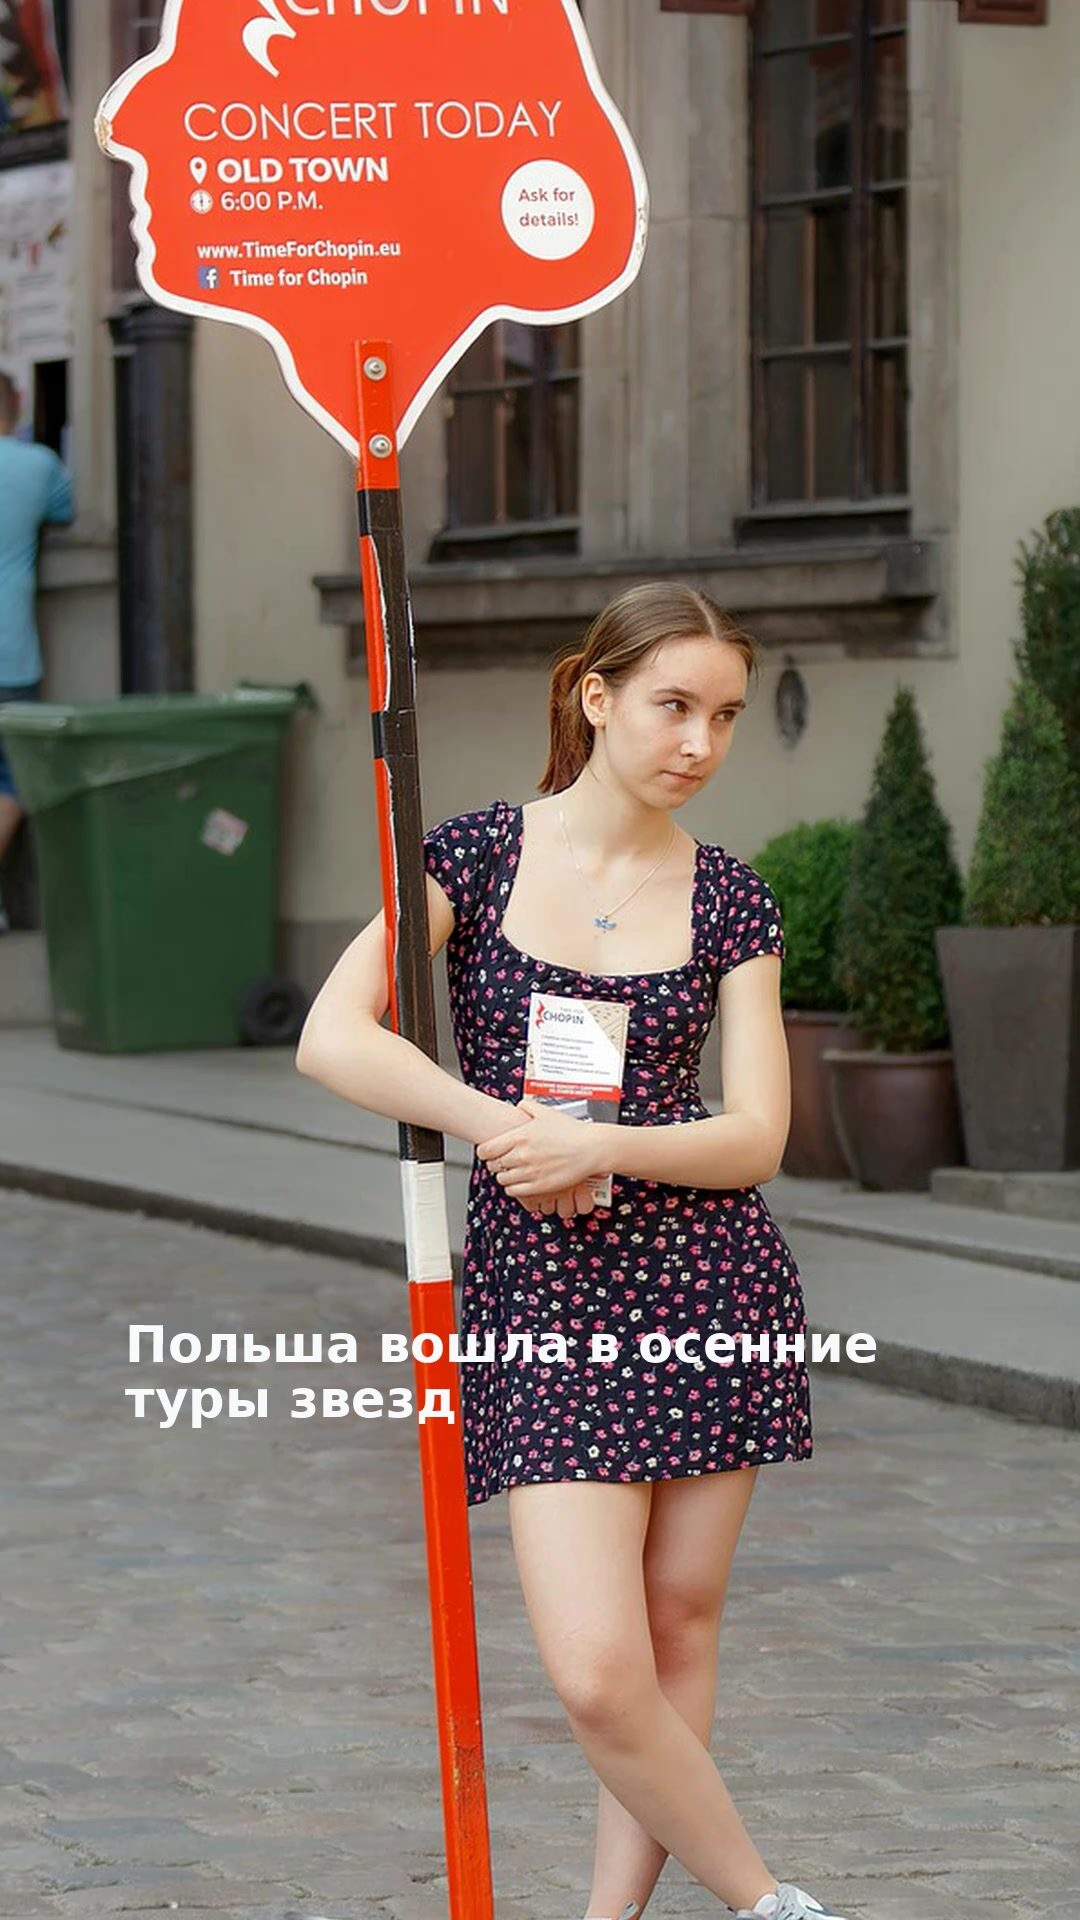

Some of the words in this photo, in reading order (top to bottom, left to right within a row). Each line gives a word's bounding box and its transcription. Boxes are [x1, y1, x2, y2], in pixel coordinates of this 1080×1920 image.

[184, 102, 397, 141] CONCERT
[414, 100, 562, 139] TODAY
[216, 157, 284, 184] OLD
[288, 156, 389, 183] TOWN
[220, 191, 271, 211] 6:00
[277, 190, 323, 210] P.M.
[518, 187, 549, 202] Ask
[552, 187, 575, 202] for
[519, 211, 579, 228] details!
[196, 239, 401, 261] www.TimeForChopin.eu
[229, 269, 275, 287] Time
[277, 268, 304, 286] for
[306, 268, 368, 289] Chopin
[543, 1009, 585, 1025] CHOPIN
